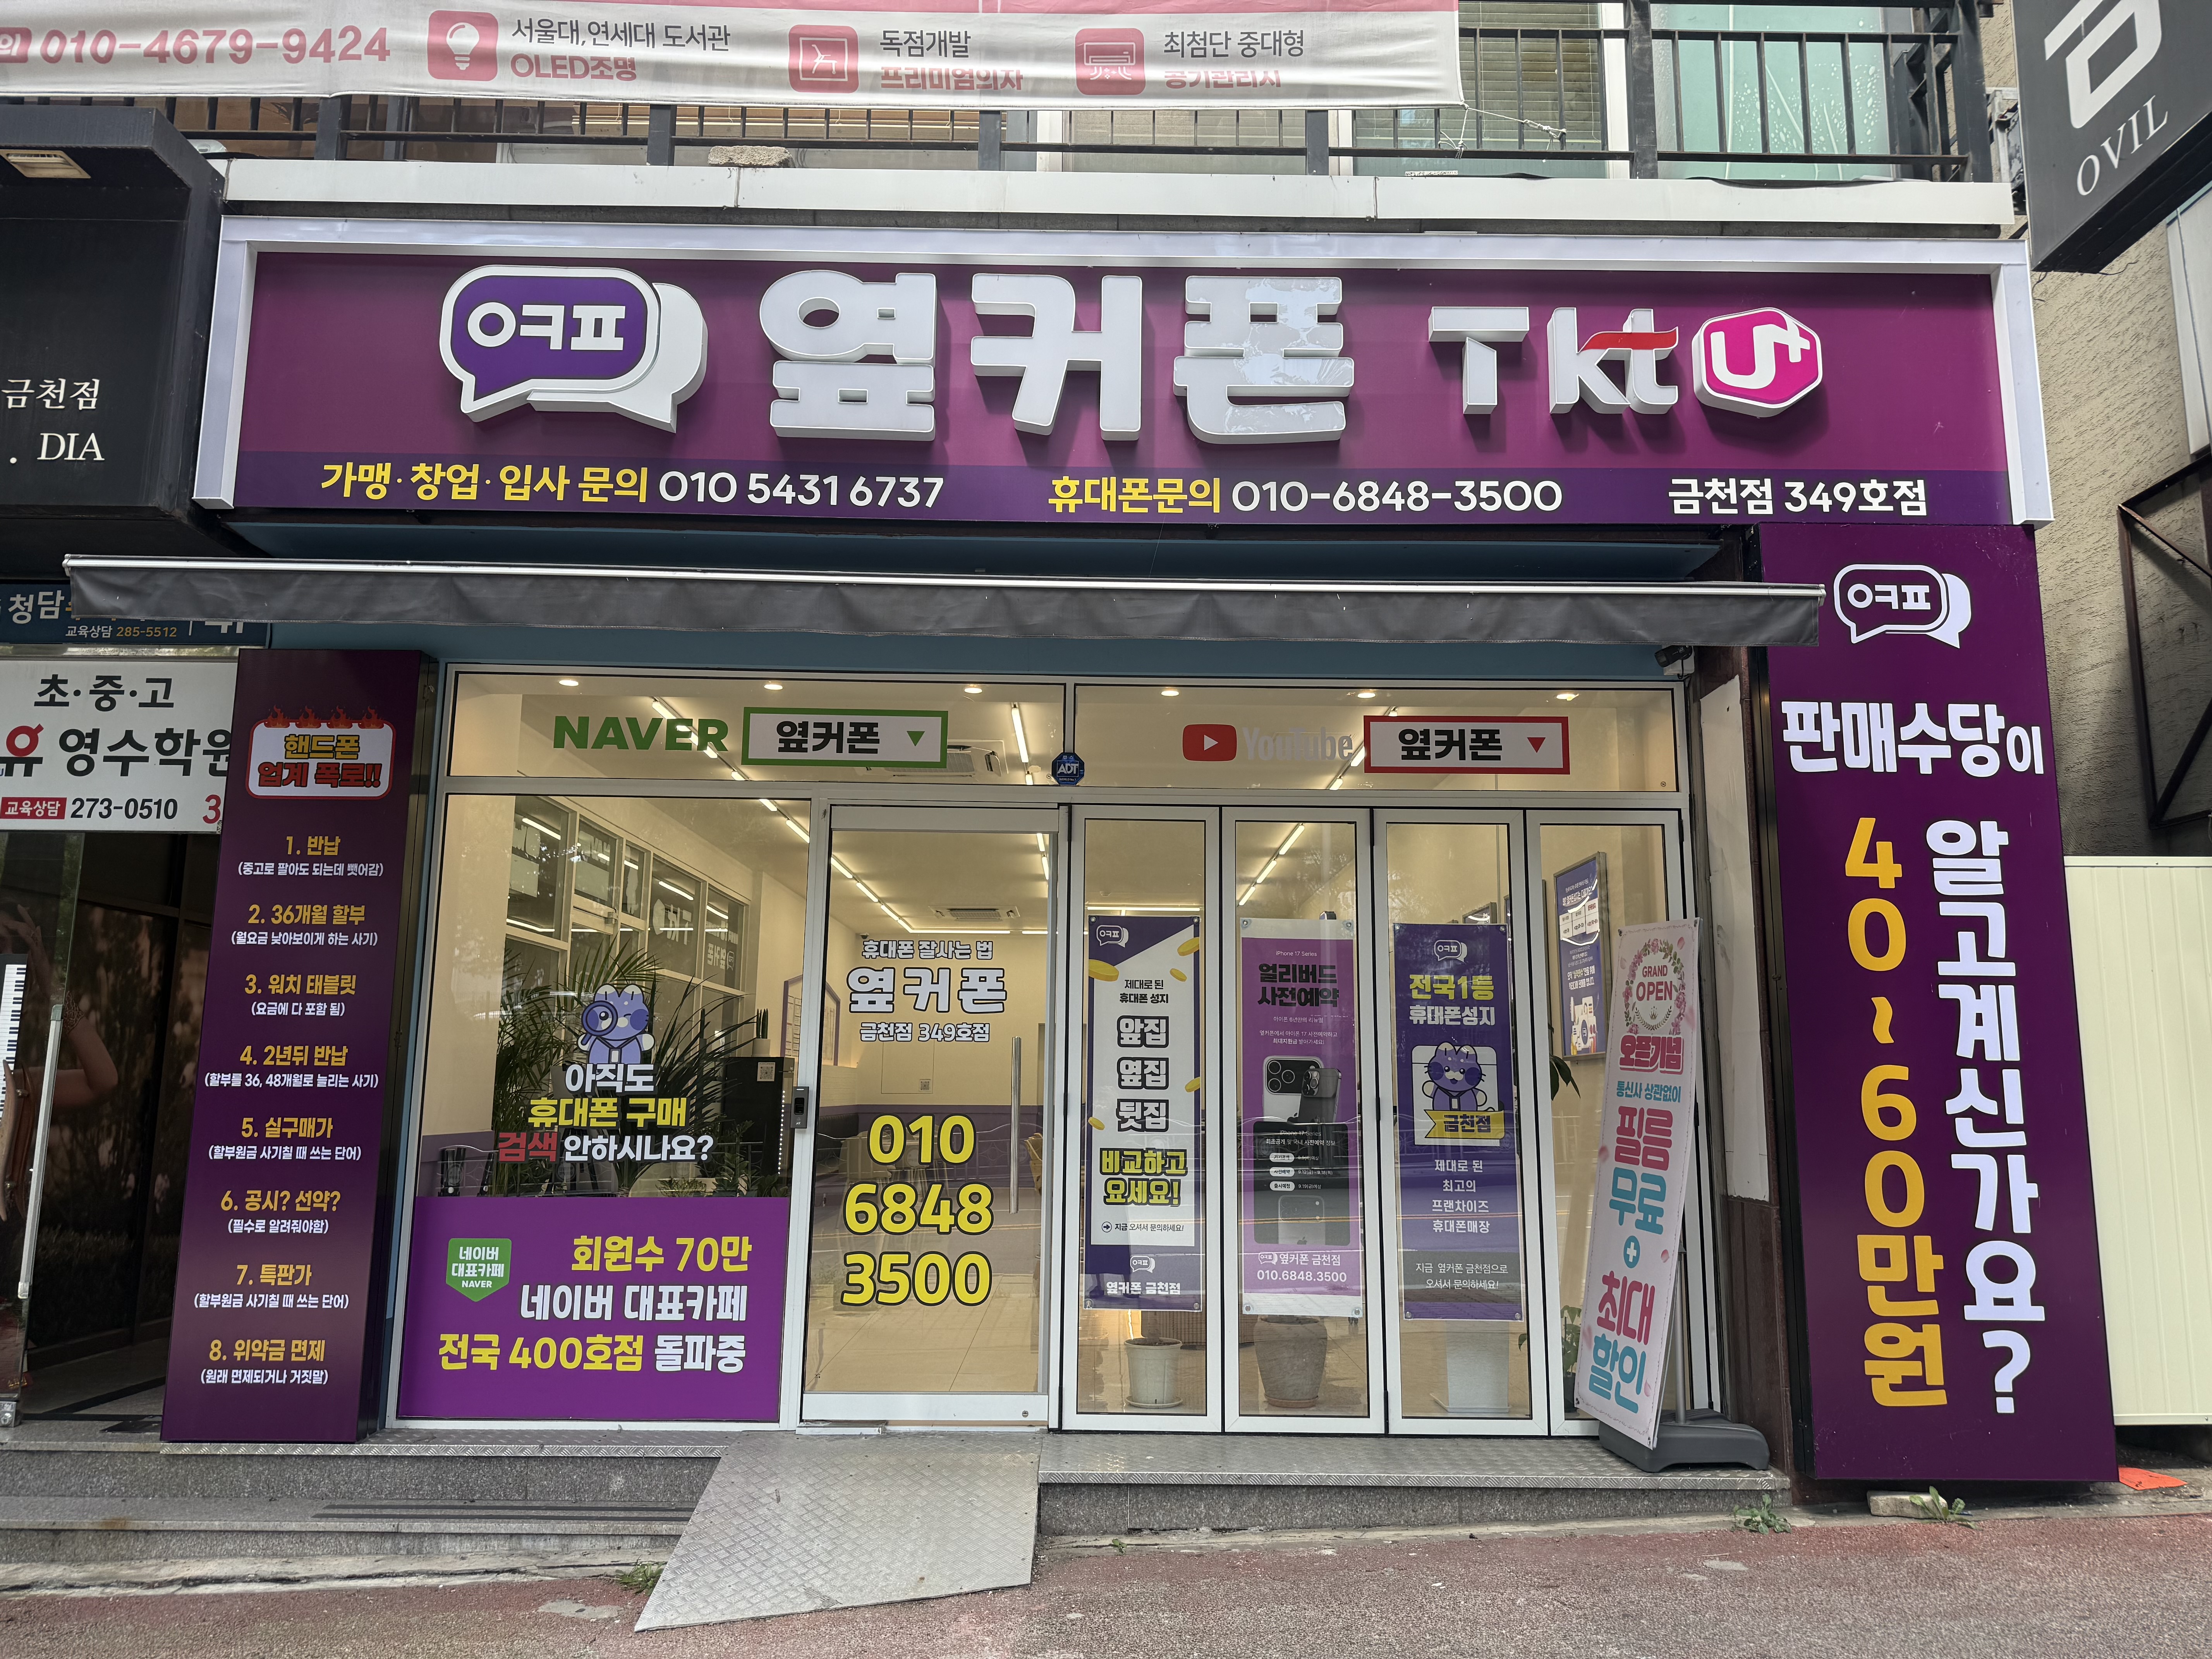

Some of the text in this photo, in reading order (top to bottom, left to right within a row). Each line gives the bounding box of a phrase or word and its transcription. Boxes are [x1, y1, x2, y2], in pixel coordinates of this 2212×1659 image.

[40, 25, 390, 64] 010-4679-9424
[512, 18, 731, 51] 서울대,연세대 도서관
[880, 30, 971, 58] 독점개발
[1163, 31, 1305, 58] 최첨단 중대형
[510, 53, 637, 82] OLED조명
[881, 66, 1024, 91] 프리미엄의자
[2076, 95, 2168, 196] OVIL
[759, 270, 1355, 444] 옆커폰
[1, 378, 100, 410] 금천점
[37, 433, 105, 461] DIA
[579, 467, 944, 508] 문의 010 5431 6737
[1048, 476, 1563, 514] 휴대폰문의 010-6848-3500
[1668, 478, 1927, 516] 금천점 349호점
[65, 625, 177, 638] 교육상담 285-5512
[284, 734, 360, 760] 핸드폰
[553, 716, 729, 752] NAVER
[776, 721, 880, 755] 옆커폰
[1242, 726, 1353, 761] YouTube
[1398, 729, 1502, 761] 옆커폰
[1781, 701, 2044, 778] 판매수당이
[59, 728, 232, 777] 영수학원
[258, 762, 382, 788] 업계 폭로!!
[1058, 763, 1079, 774] ADT
[5, 800, 60, 817] 교육상담
[70, 798, 178, 819] 273-0510
[286, 836, 340, 856] 1. 반납
[238, 862, 384, 877] (중고로 팔아도 되는데 뺏어감)
[248, 904, 365, 925] 2. 36개월 할부
[231, 931, 378, 946] (월요금 낮아보이게 하는 사기)
[862, 940, 993, 960] 휴대폰 잘사는 법
[1125, 979, 1164, 990] 제대로 된
[1259, 963, 1337, 983] 얼리버드
[1642, 965, 1668, 977] GRAND
[847, 967, 1007, 1013] 옆커폰
[1120, 993, 1169, 1004] 휴대폰 성지
[1257, 986, 1339, 1007] 사전예약
[1410, 975, 1494, 1000] 전국1등
[1636, 981, 1673, 1001] OPEN
[1409, 1005, 1495, 1025] 휴대폰성지
[1117, 1015, 1169, 1048] 앞집
[1618, 1034, 1684, 1075] 오픈기념
[565, 1063, 654, 1092] 아직도
[1117, 1057, 1169, 1090] 옆집
[1616, 1080, 1681, 1103] 통신사 상관없이
[529, 1097, 687, 1127] 휴대폰 구매
[1116, 1099, 1169, 1132] 뒷집
[1443, 1114, 1491, 1133] 금천점
[1926, 820, 2045, 1413] 알고계신가요?
[241, 1118, 333, 1138] 5. 실구매가
[867, 1113, 976, 1165] 010
[1614, 1106, 1673, 1171] 필름
[208, 1146, 361, 1161] (할부원금 사기칠 때 쓰는 단어)
[498, 1132, 714, 1161] 검색 안하시나요?
[1100, 1147, 1188, 1176] 비교하고
[1435, 1159, 1483, 1173] 제대로 된
[1104, 1178, 1181, 1207] 요세요!
[1443, 1180, 1476, 1192] 최고의
[221, 1190, 341, 1212] 6. 공시? 선약?
[843, 1182, 994, 1235] 6848
[1432, 1200, 1489, 1213] 프랜차이즈
[1609, 1167, 1666, 1235] 무료
[228, 1219, 329, 1234] (필수로 알려줘야함)
[1129, 1223, 1148, 1231] 오셔서
[1150, 1223, 1184, 1232] 문의하세요!
[1433, 1219, 1490, 1233] 휴대폰매장
[459, 1247, 498, 1261] 네이버
[571, 1235, 752, 1273] 회원수 70만
[1279, 1254, 1340, 1266] 옆커폰 금천점
[451, 1263, 504, 1278] 대표카페
[840, 1251, 992, 1306] 3500
[1257, 1270, 1347, 1282] 010.6848.3500
[1416, 1263, 1508, 1274] 지금 옆커폰 금천점으로
[1425, 1279, 1498, 1290] 오셔서 문의하세요!
[520, 1285, 747, 1321] 네이버 대표카페
[1597, 1271, 1655, 1346] 최대
[209, 1340, 326, 1362] 8. 위약금 면제
[438, 1333, 746, 1373] 전국 400호점 돌파중
[201, 1369, 329, 1385] (원래 면제되거나 거짓말)
[1589, 1333, 1647, 1414] 할인
